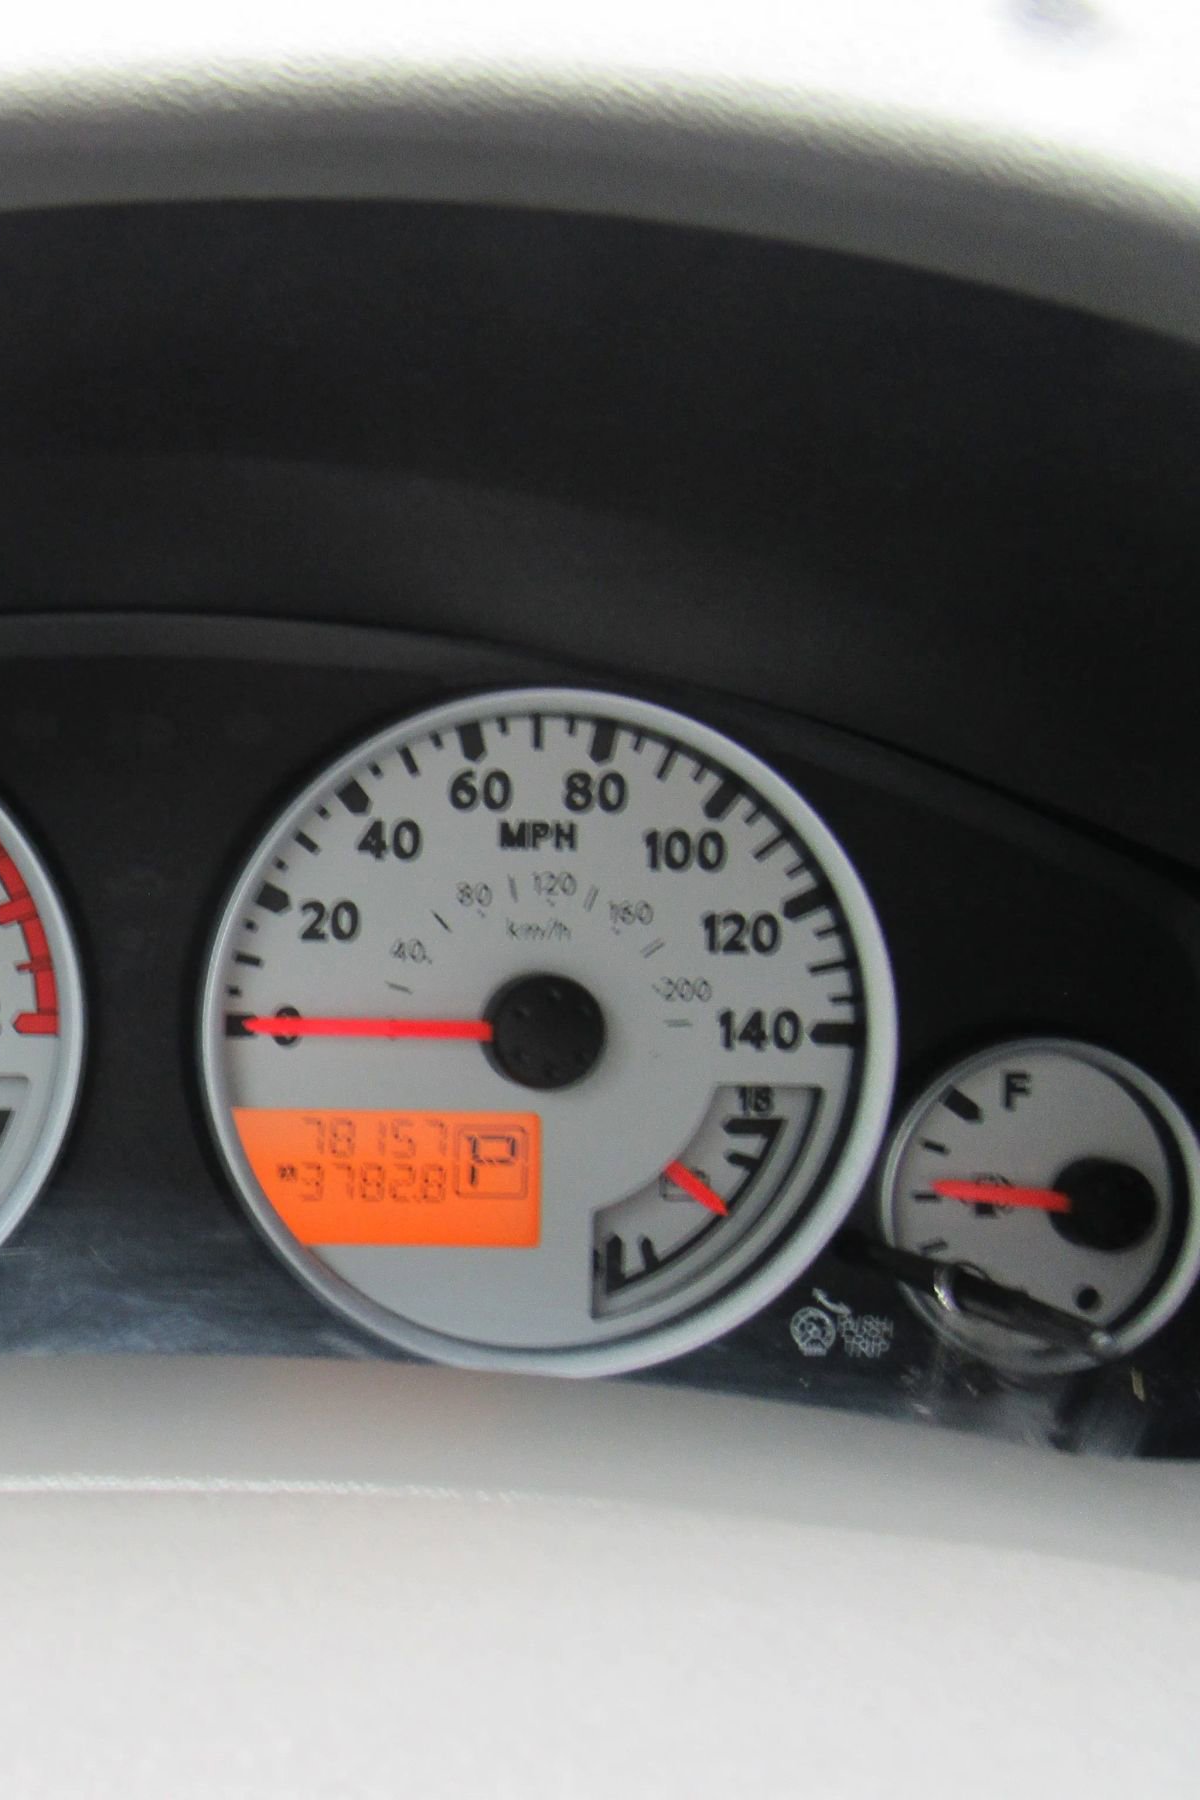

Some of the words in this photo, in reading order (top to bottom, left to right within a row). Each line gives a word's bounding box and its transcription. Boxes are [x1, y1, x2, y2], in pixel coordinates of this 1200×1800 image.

[449, 769, 513, 812] 60
[564, 769, 627, 812] 80
[357, 819, 422, 861] 40
[500, 822, 578, 852] MPH
[645, 829, 726, 871] 100
[532, 870, 578, 898] 120
[300, 899, 360, 942] 20
[704, 911, 781, 955] 120
[389, 937, 429, 964] 40
[719, 1009, 801, 1051] 140
[738, 1087, 775, 1115] 18
[1005, 1073, 1032, 1112] F
[303, 1117, 448, 1158] 78157
[467, 1135, 518, 1186] P
